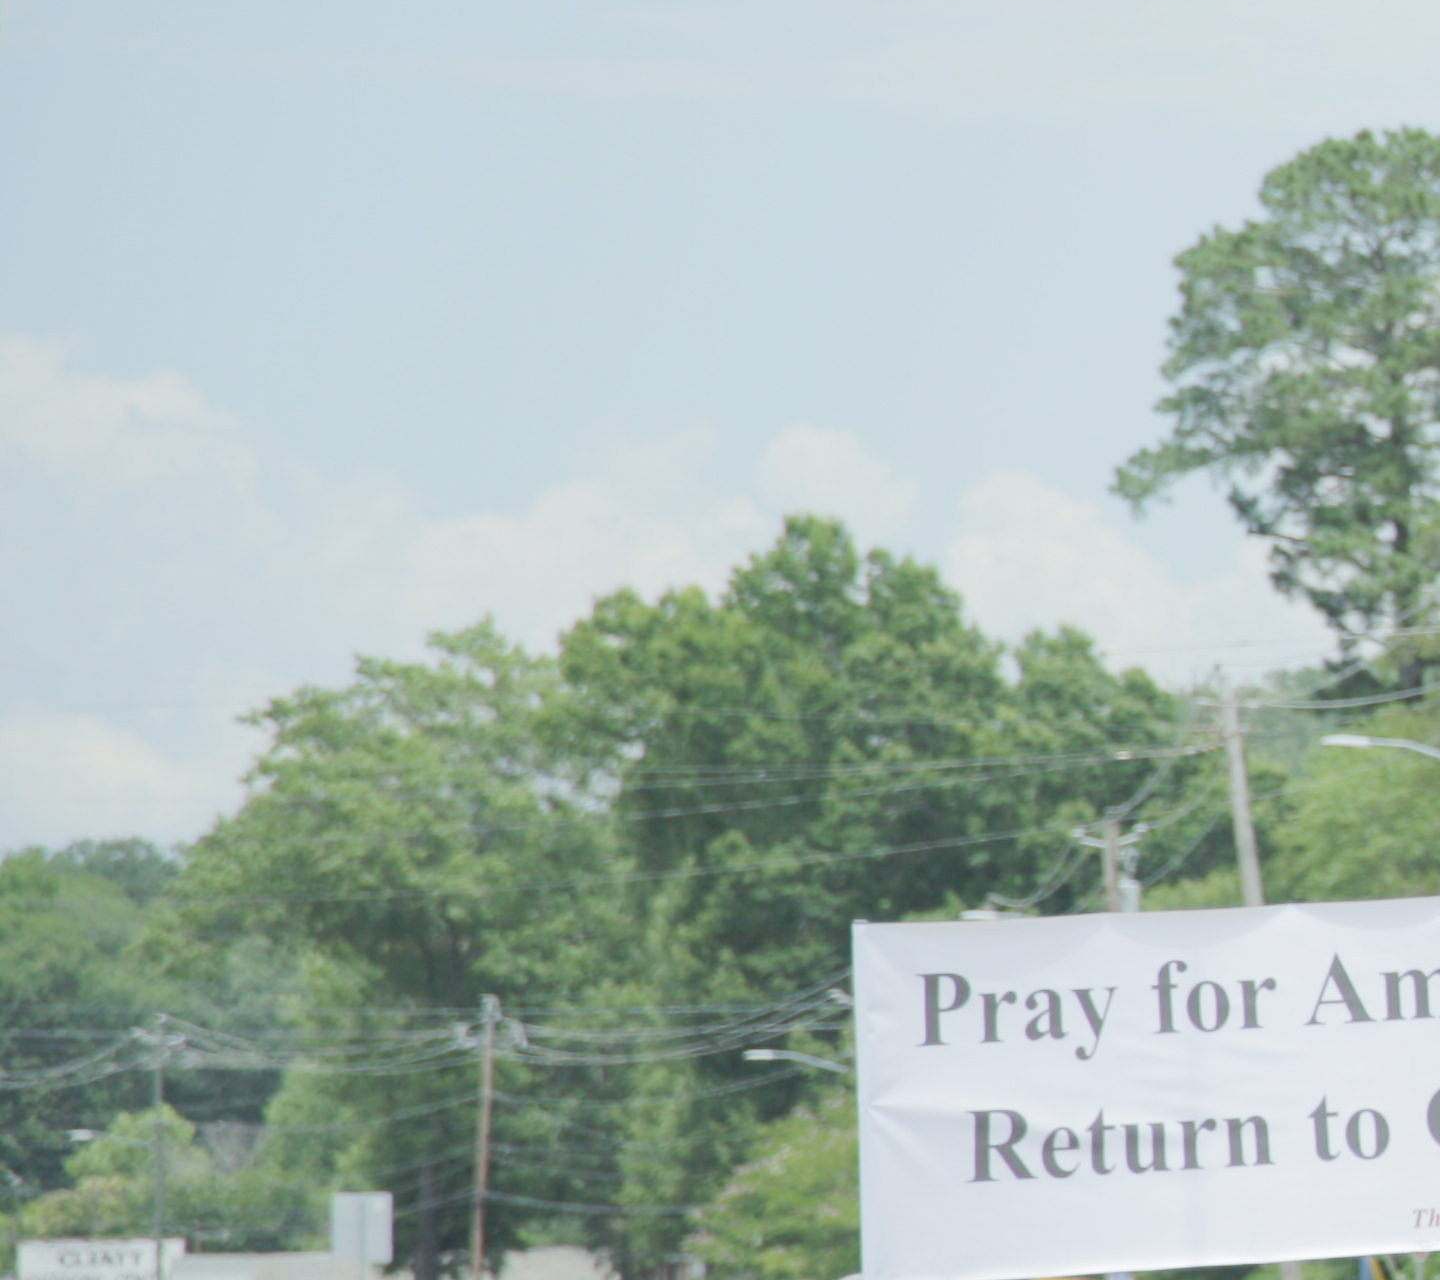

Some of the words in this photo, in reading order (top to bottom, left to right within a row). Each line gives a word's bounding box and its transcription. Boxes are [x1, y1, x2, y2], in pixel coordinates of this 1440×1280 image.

[915, 972, 1118, 1061] Pray
[1150, 959, 1277, 1034] for
[965, 1108, 1275, 1184] Return
[1306, 1094, 1391, 1162] to
